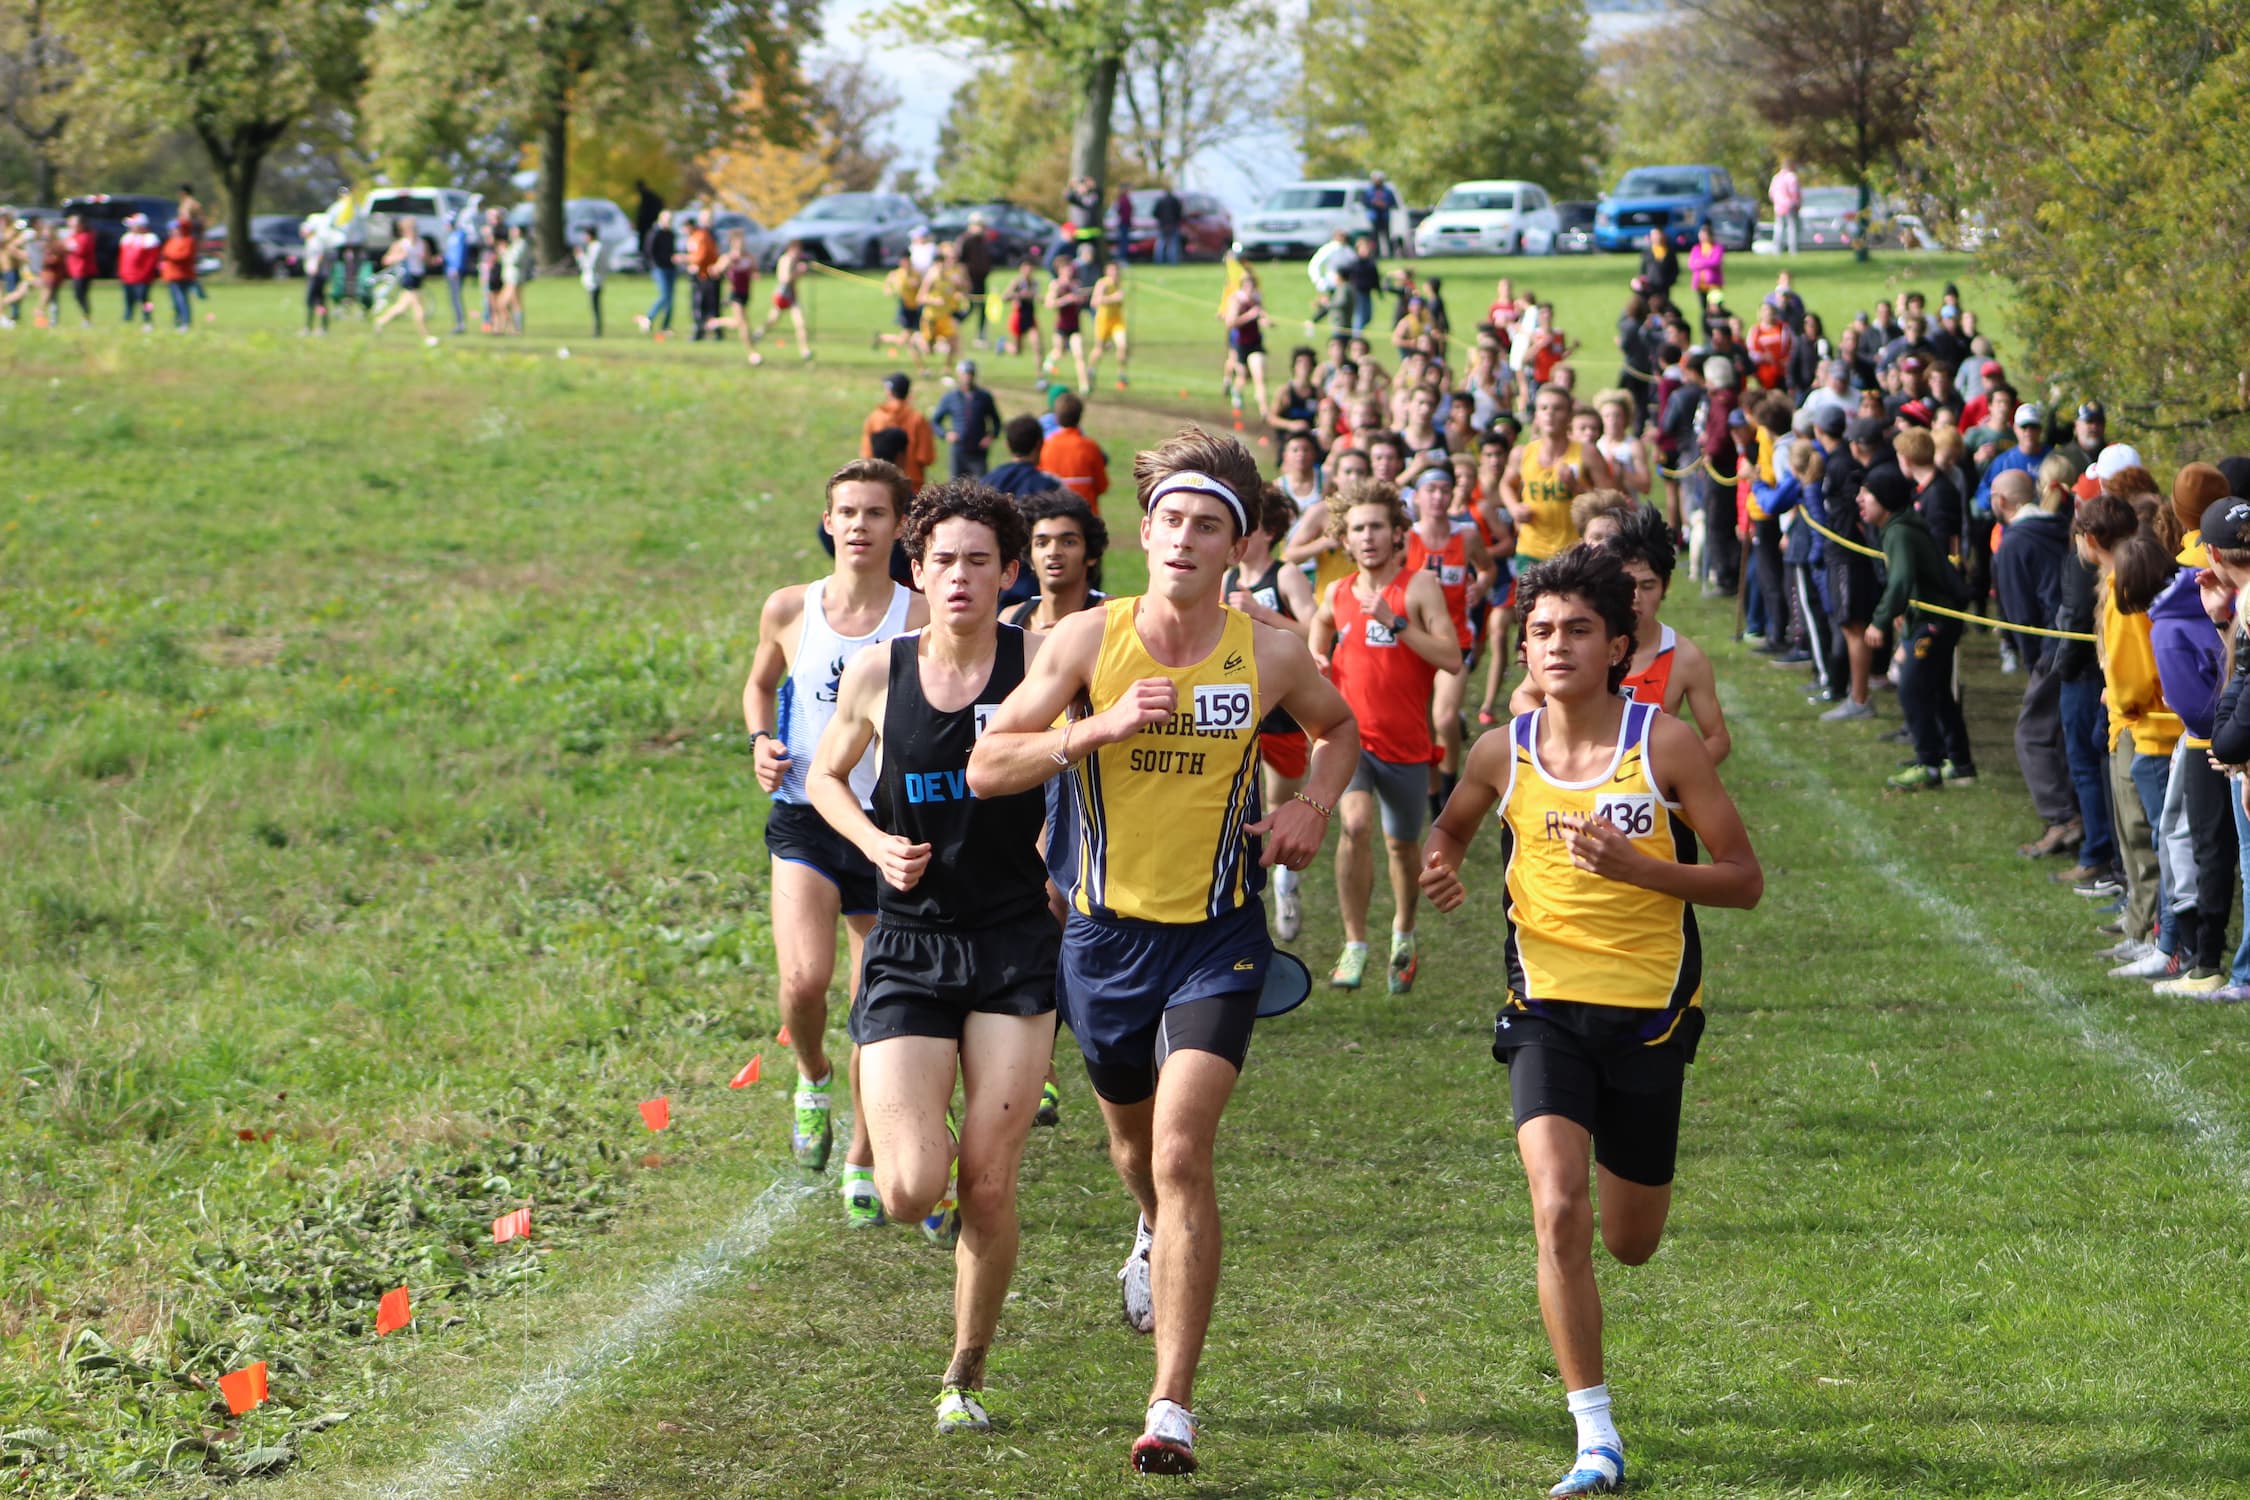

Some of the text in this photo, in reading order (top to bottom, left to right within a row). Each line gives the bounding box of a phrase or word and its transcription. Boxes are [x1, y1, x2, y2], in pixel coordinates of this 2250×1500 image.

[1195, 692, 1250, 726] 159
[1130, 748, 1206, 775] SOUTH
[1599, 802, 1652, 835] 436
